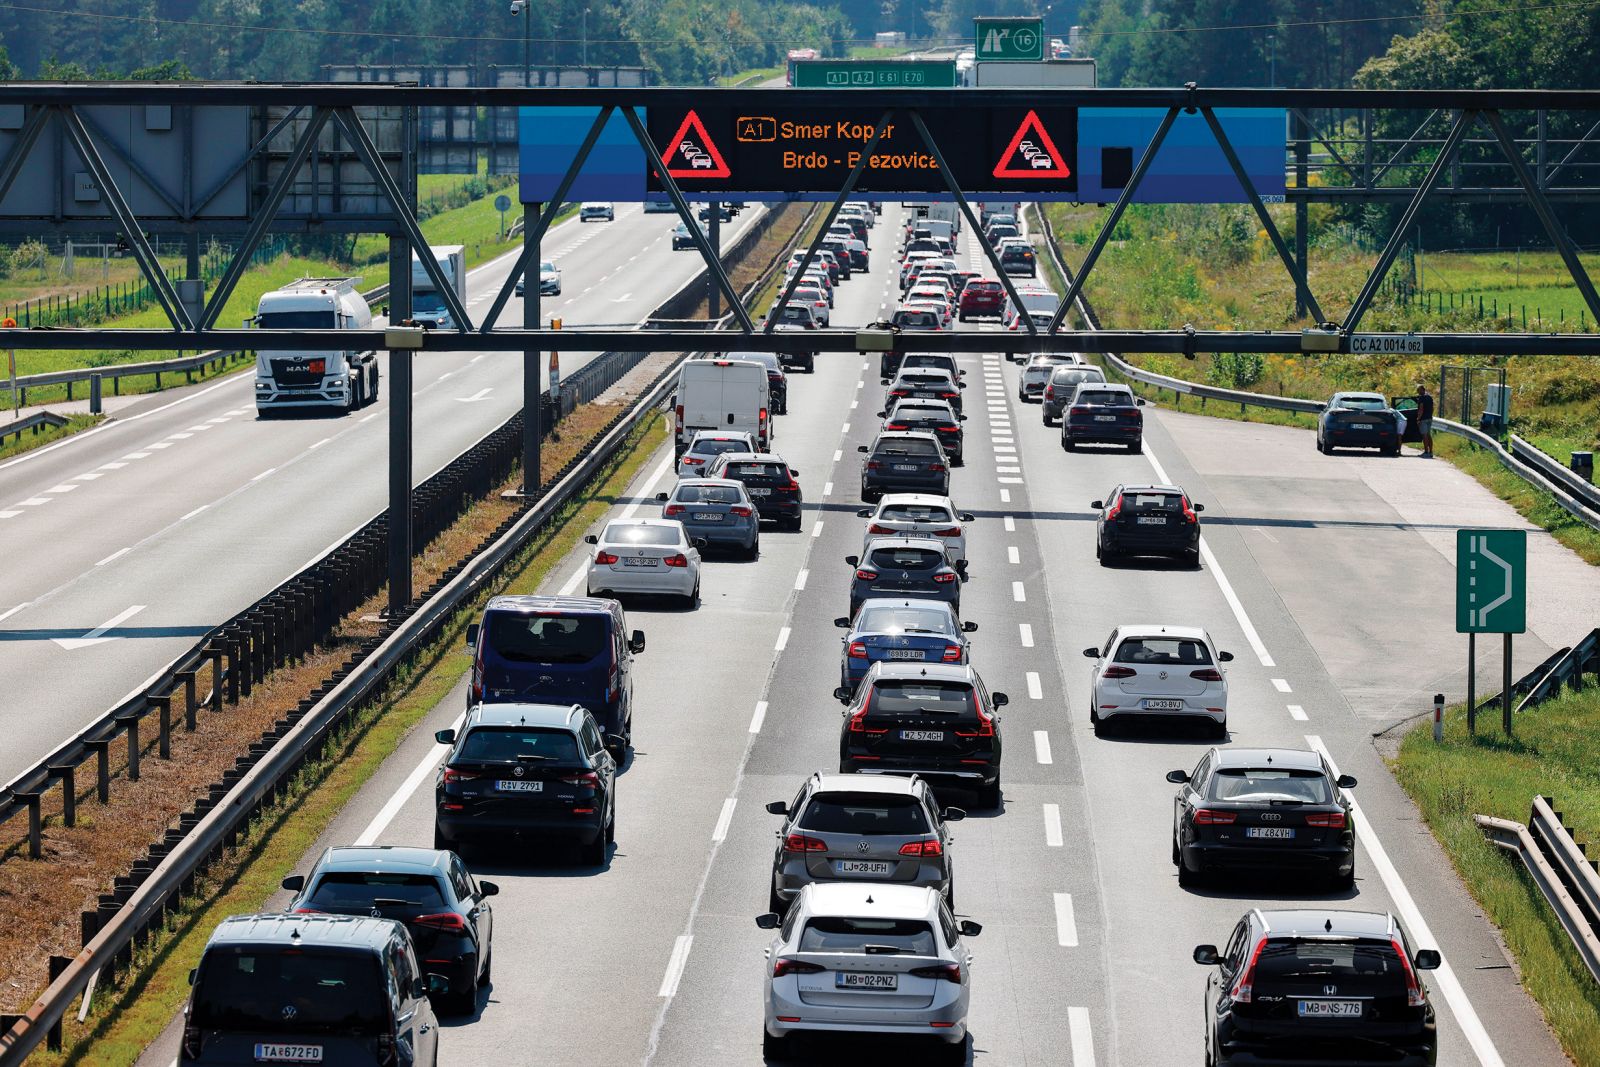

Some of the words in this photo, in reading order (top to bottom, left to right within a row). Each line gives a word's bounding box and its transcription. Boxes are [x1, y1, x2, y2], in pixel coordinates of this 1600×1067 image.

[1019, 35, 1032, 46] 16
[832, 74, 842, 82] A1
[857, 73, 868, 82] A2
[744, 122, 763, 136] A1
[781, 121, 831, 139] Smer
[783, 151, 828, 169] Brdo
[847, 151, 940, 169] Bezovica
[1353, 338, 1367, 351] CC
[1369, 338, 1381, 351] A2
[1384, 339, 1406, 351] 0014
[1408, 341, 1421, 351] 062
[905, 731, 915, 739] WZ
[917, 731, 942, 740] 574GH
[520, 782, 541, 790] 2791
[1252, 829, 1261, 837] FT
[1264, 829, 1291, 838] 484VH
[264, 1046, 277, 1057] TA
